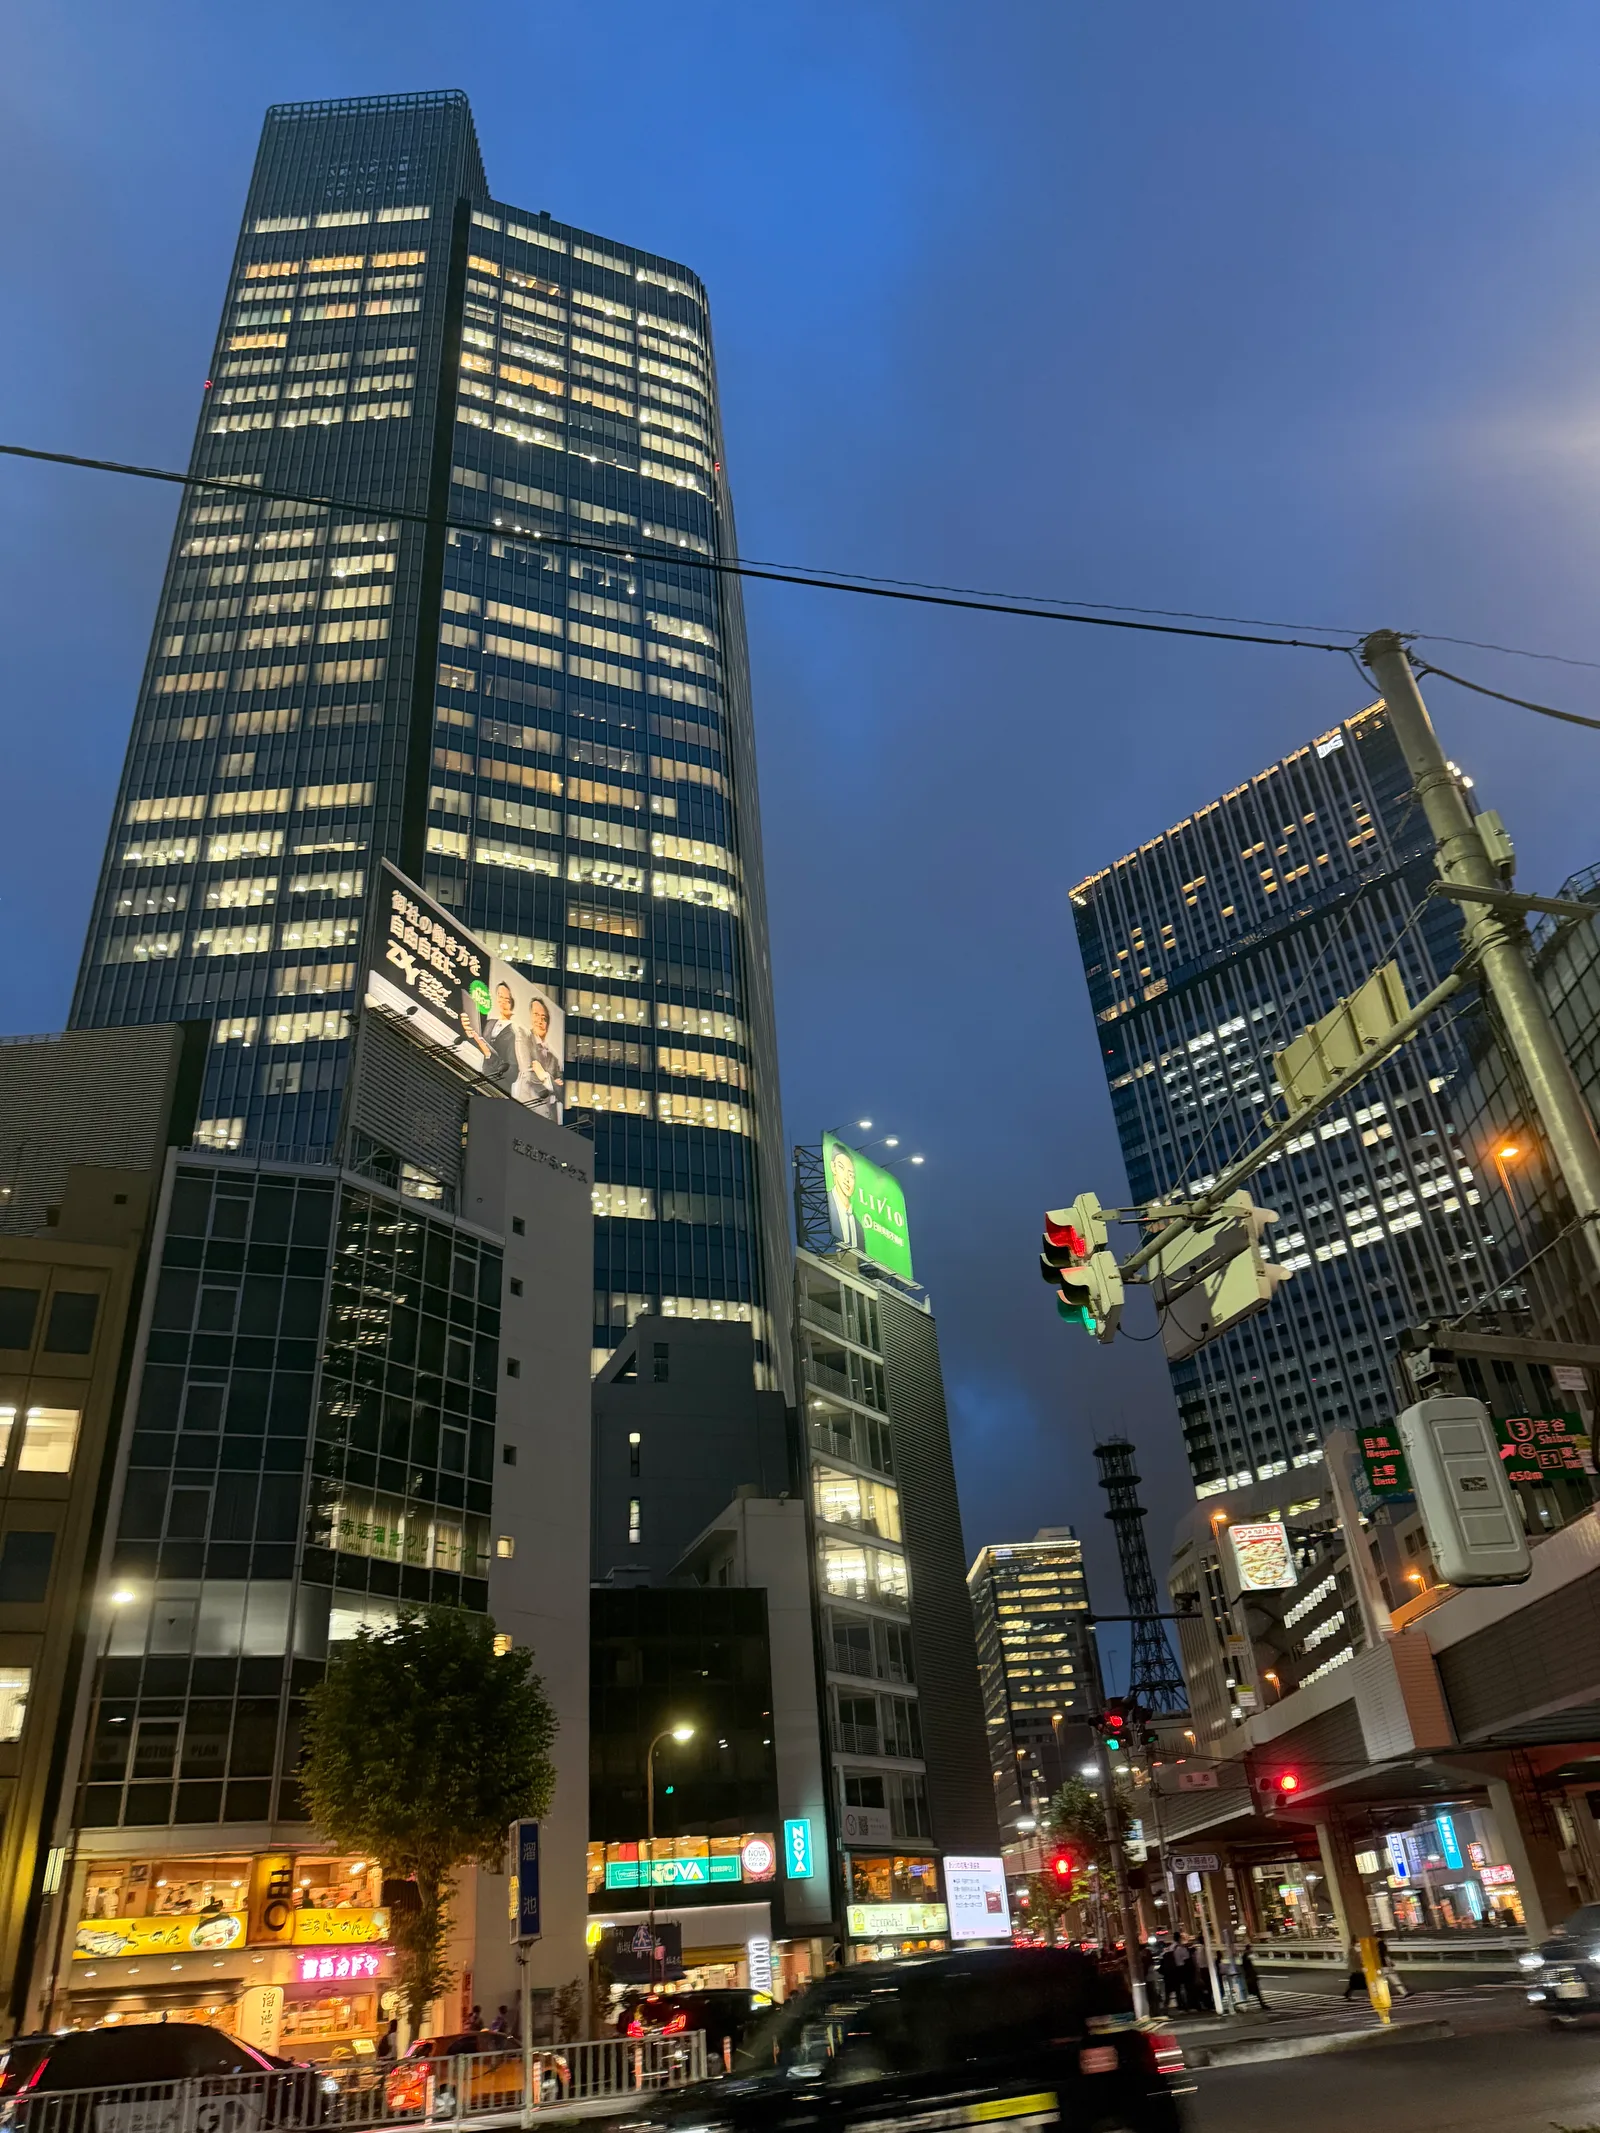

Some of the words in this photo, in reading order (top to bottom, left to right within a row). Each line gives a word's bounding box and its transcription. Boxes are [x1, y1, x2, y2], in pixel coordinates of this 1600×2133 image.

[858, 1187, 904, 1228] LIVIO
[1515, 1422, 1529, 1437] 3
[1534, 1418, 1566, 1433] 渋谷
[1363, 1437, 1389, 1449] 目黒
[1366, 1449, 1401, 1458] Meguro
[1541, 1453, 1559, 1465] E1
[1372, 1465, 1396, 1477] 上野
[1509, 1471, 1544, 1481] 450m
[1373, 1478, 1398, 1486] Ueno
[792, 1826, 806, 1873] NOVA
[523, 1842, 537, 1916] 溜池
[651, 1862, 704, 1884] NOVA
